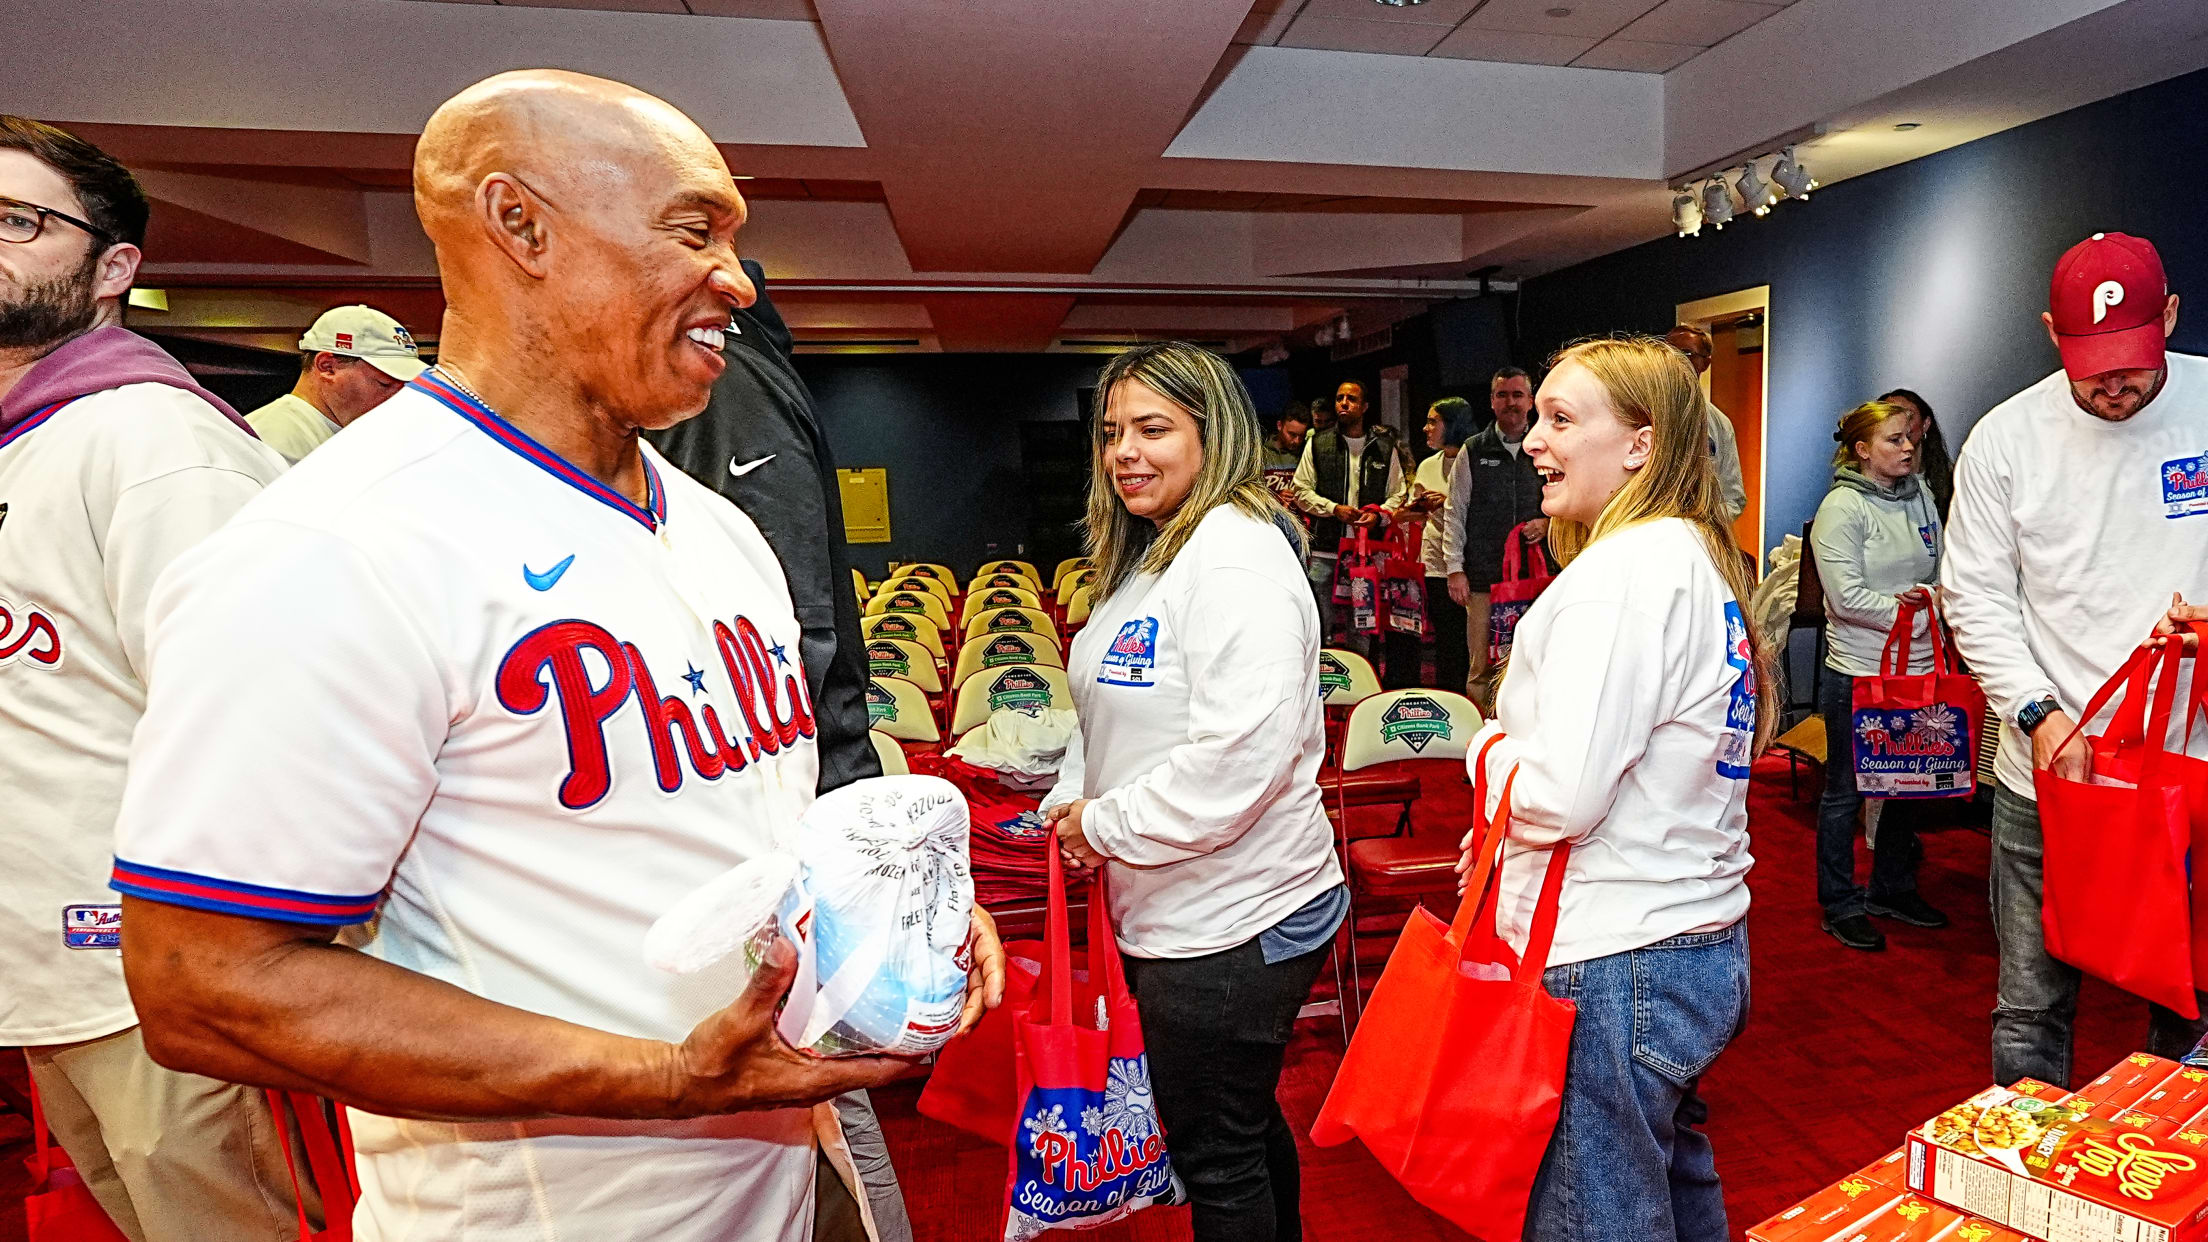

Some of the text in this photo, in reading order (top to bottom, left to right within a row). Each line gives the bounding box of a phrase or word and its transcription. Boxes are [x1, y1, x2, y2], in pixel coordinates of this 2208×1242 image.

[2093, 280, 2124, 324] P
[2167, 491, 2196, 501] Season
[1125, 654, 1152, 668] Giving
[1003, 678, 1034, 690] Phillies
[495, 614, 817, 809] Philli
[1398, 706, 1432, 719] Phillies
[1866, 729, 1955, 756] Phillies
[1861, 757, 1968, 774] Season of Giving
[2036, 1128, 2068, 1158] TURKEY
[2072, 1137, 2128, 1177] Top
[2117, 1132, 2197, 1201] Stove
[1019, 1180, 1102, 1216] Season
[1107, 1181, 1130, 1208] of
